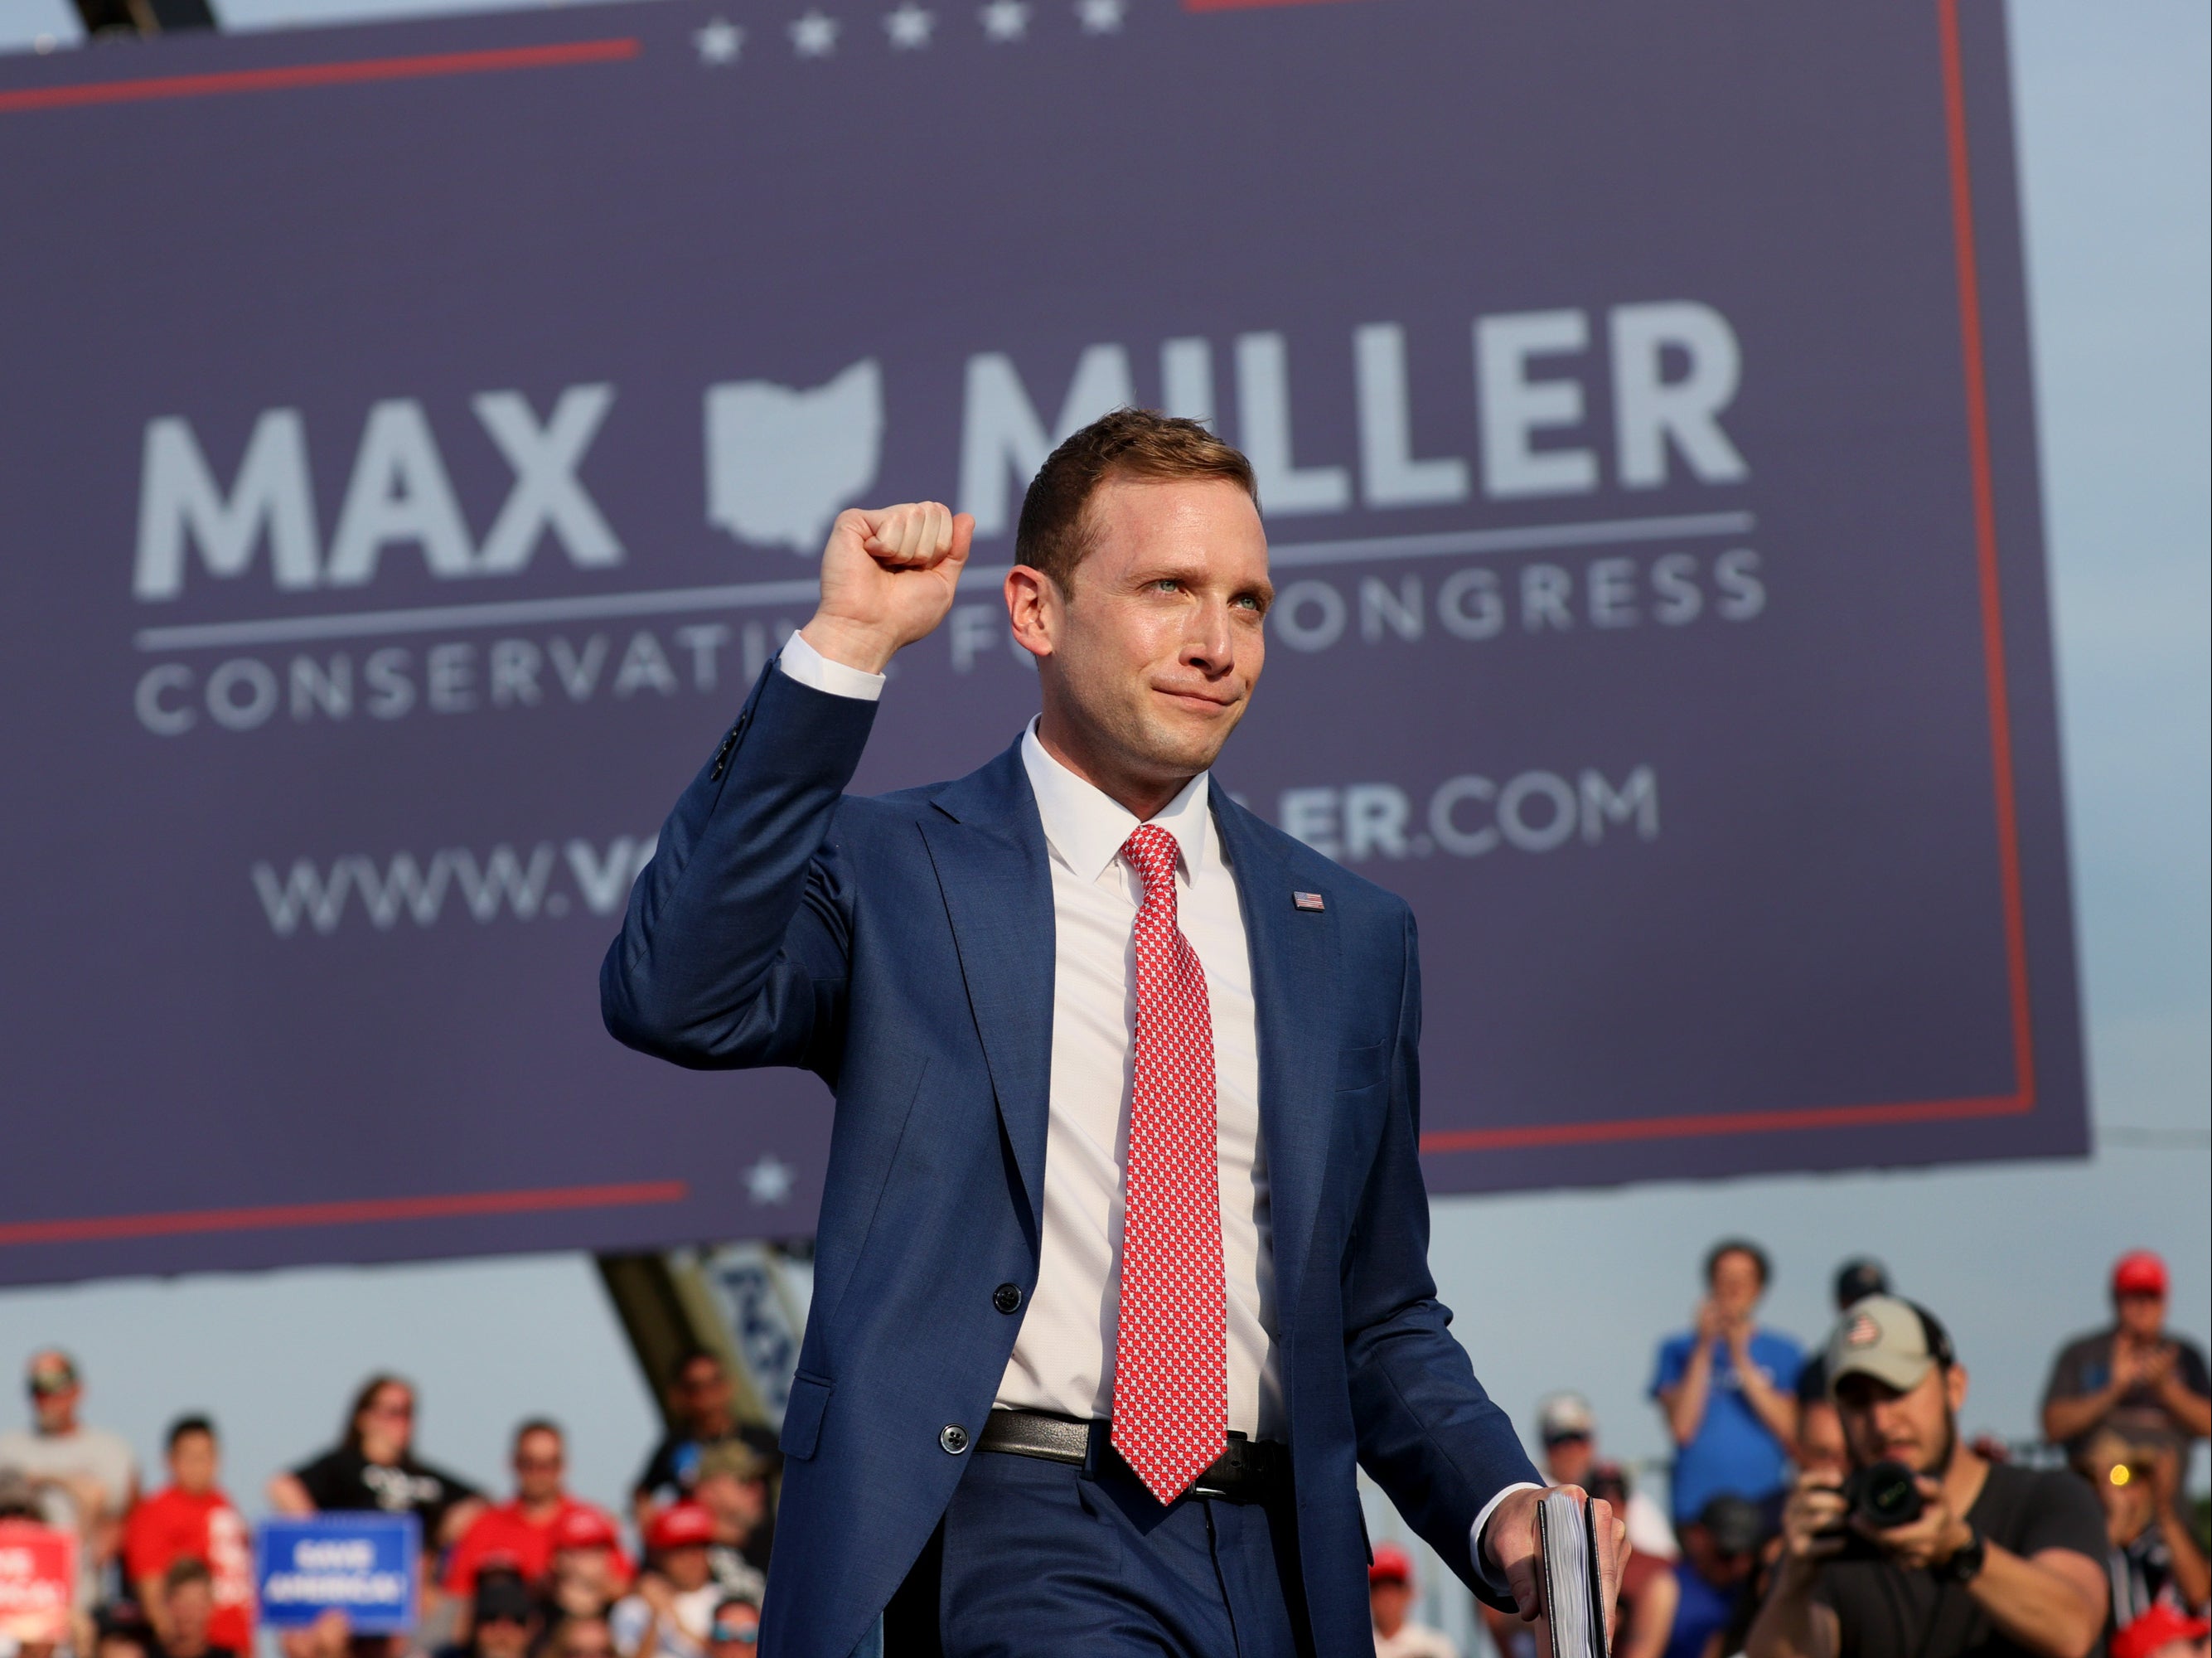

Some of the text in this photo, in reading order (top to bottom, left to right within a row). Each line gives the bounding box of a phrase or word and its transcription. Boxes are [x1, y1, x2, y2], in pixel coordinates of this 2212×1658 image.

[131, 381, 626, 603] MAX
[133, 618, 899, 738] CONSERVATI
[1273, 547, 1768, 653] ONGRESS
[250, 831, 661, 939] WWW.V
